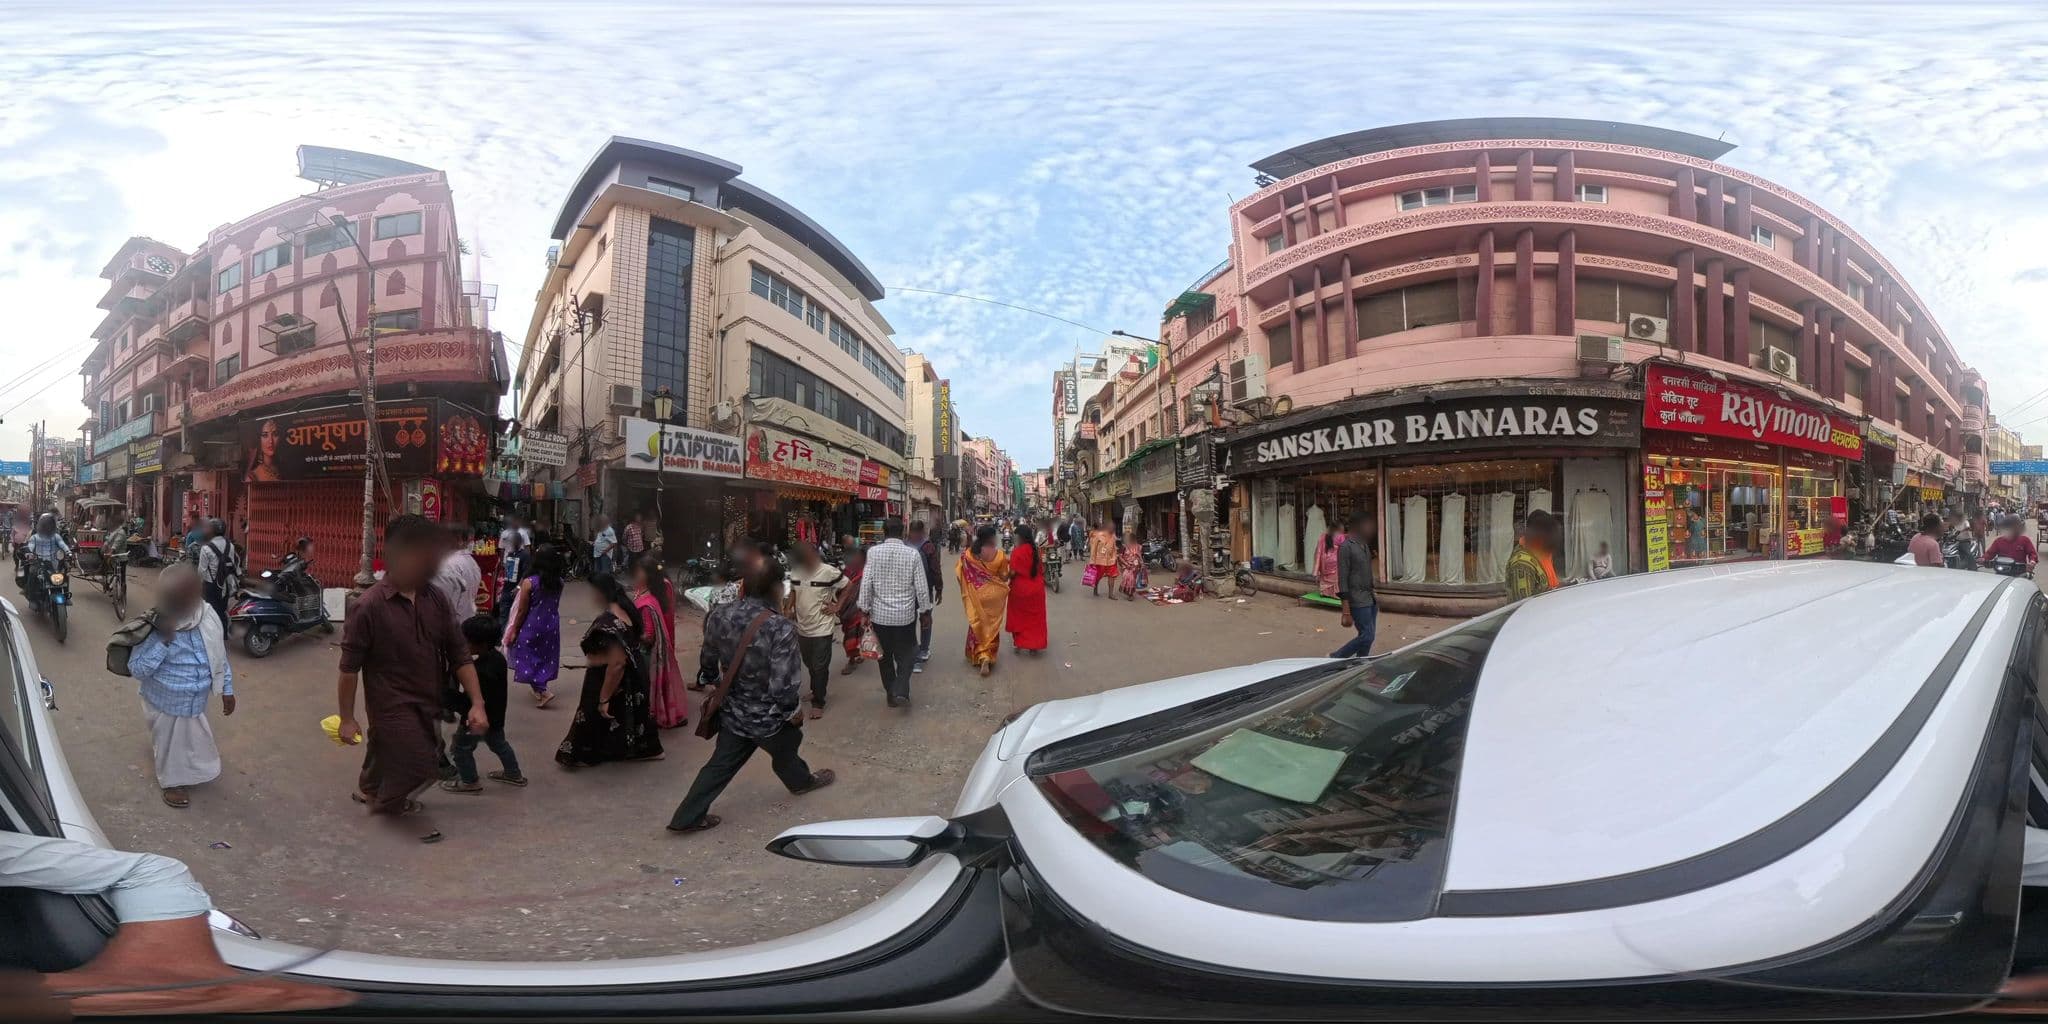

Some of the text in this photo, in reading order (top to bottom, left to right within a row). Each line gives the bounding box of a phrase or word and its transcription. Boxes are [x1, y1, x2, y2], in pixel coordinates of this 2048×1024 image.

[1662, 375, 1690, 388] बनारसी
[940, 386, 949, 453] BANARASI
[286, 420, 369, 451] आभूषण
[1257, 418, 1397, 463] SANSKARR
[1405, 406, 1599, 444] BANNARAS
[664, 437, 740, 464] JAIPURIA
[664, 456, 742, 474] SMRITI BHAWAN
[1647, 466, 1660, 474] FLAT
[1644, 474, 1665, 490] 15%
[867, 487, 882, 500] VIP
